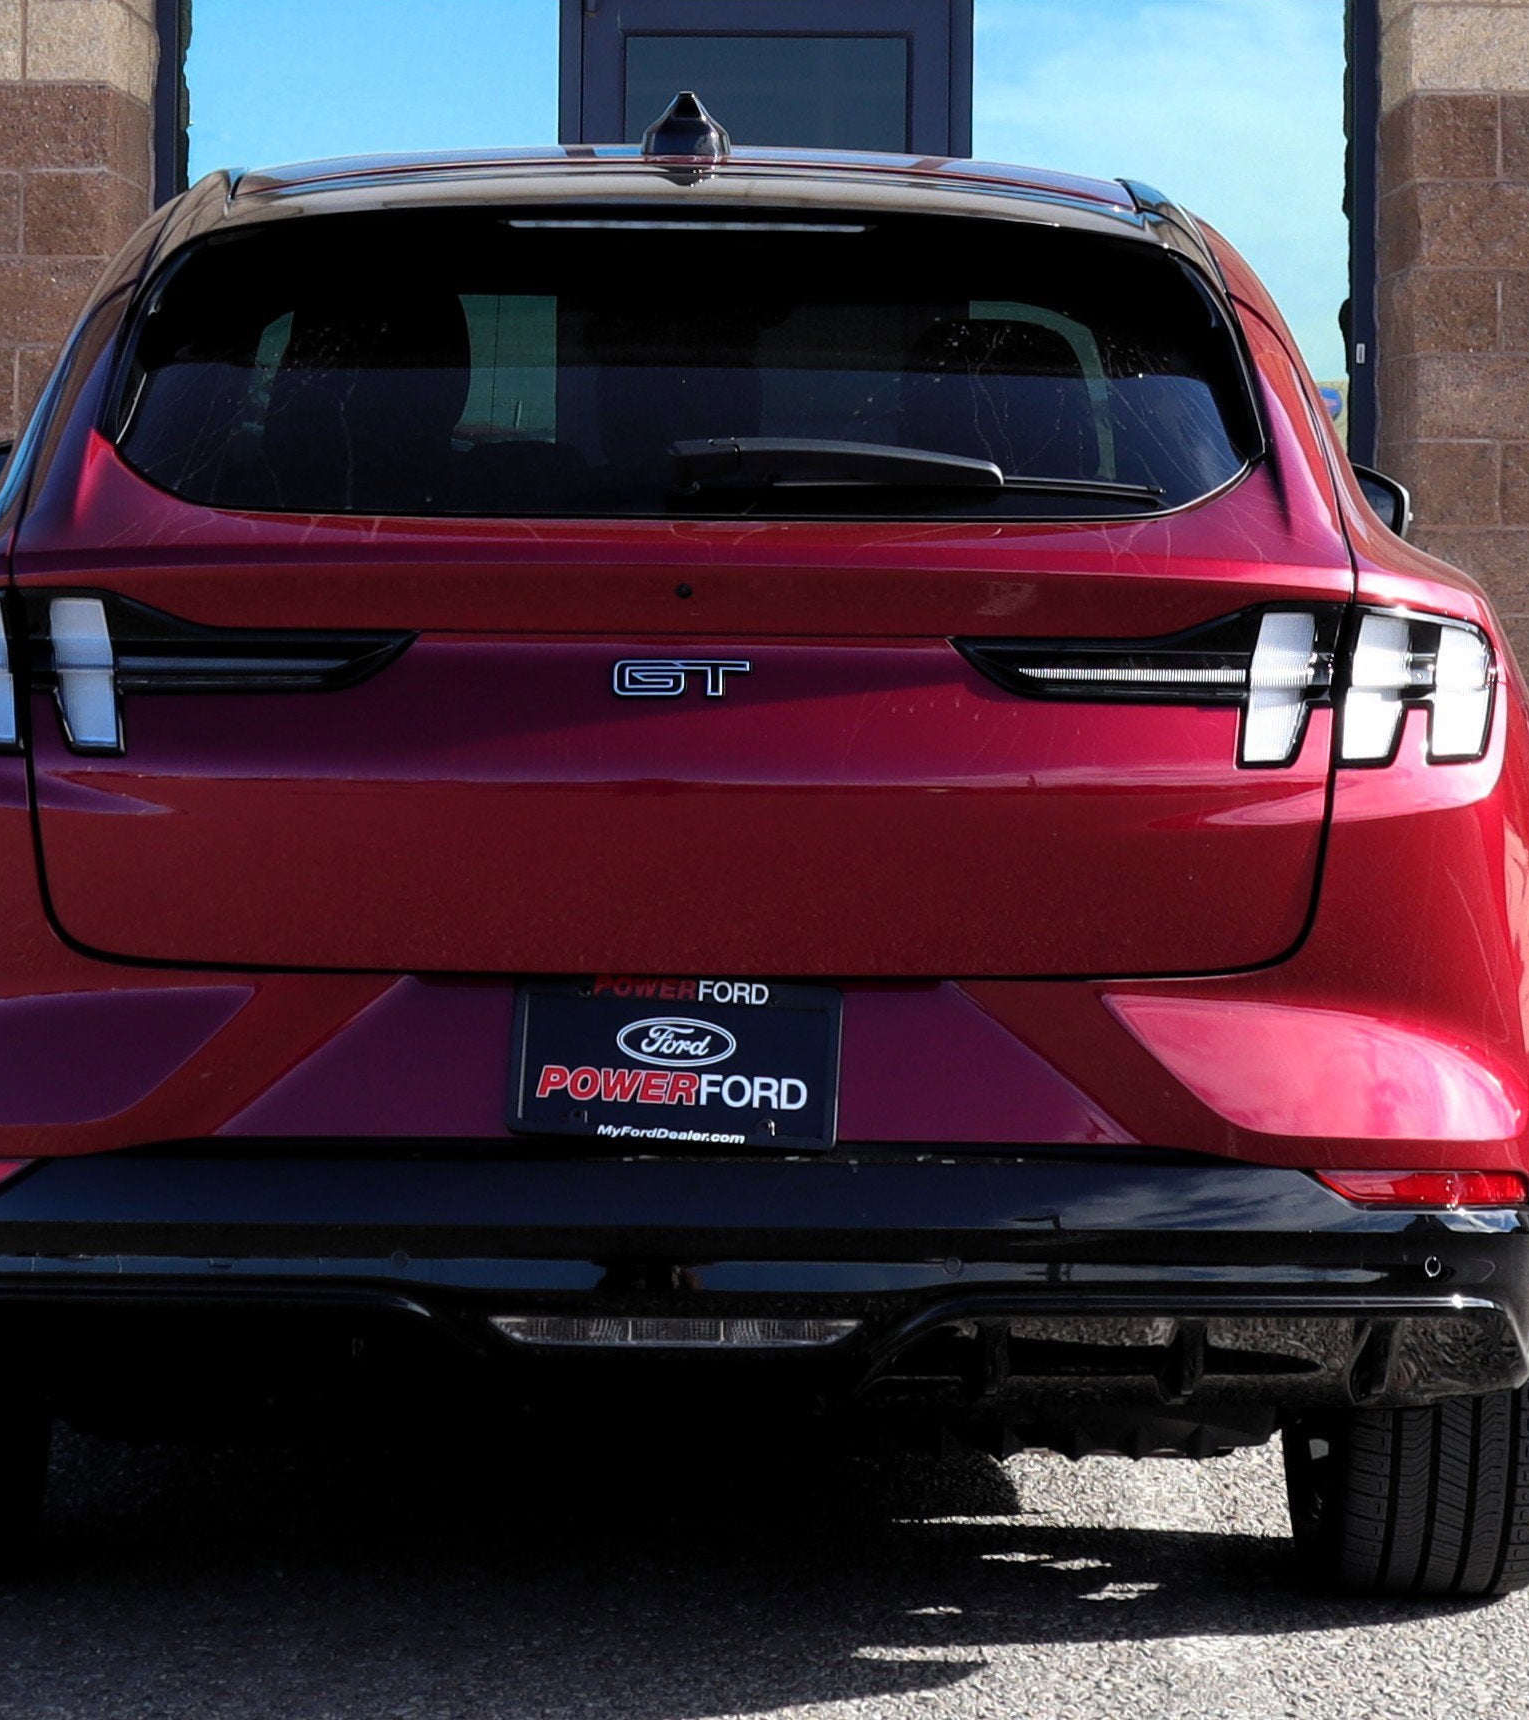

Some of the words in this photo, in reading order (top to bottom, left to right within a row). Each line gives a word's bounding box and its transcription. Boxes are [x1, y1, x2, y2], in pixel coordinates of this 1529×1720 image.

[613, 660, 750, 696] GT
[641, 1025, 710, 1057] Ford
[536, 1064, 807, 1110] POWERFORD
[597, 1124, 745, 1144] MyFordDealer.com
